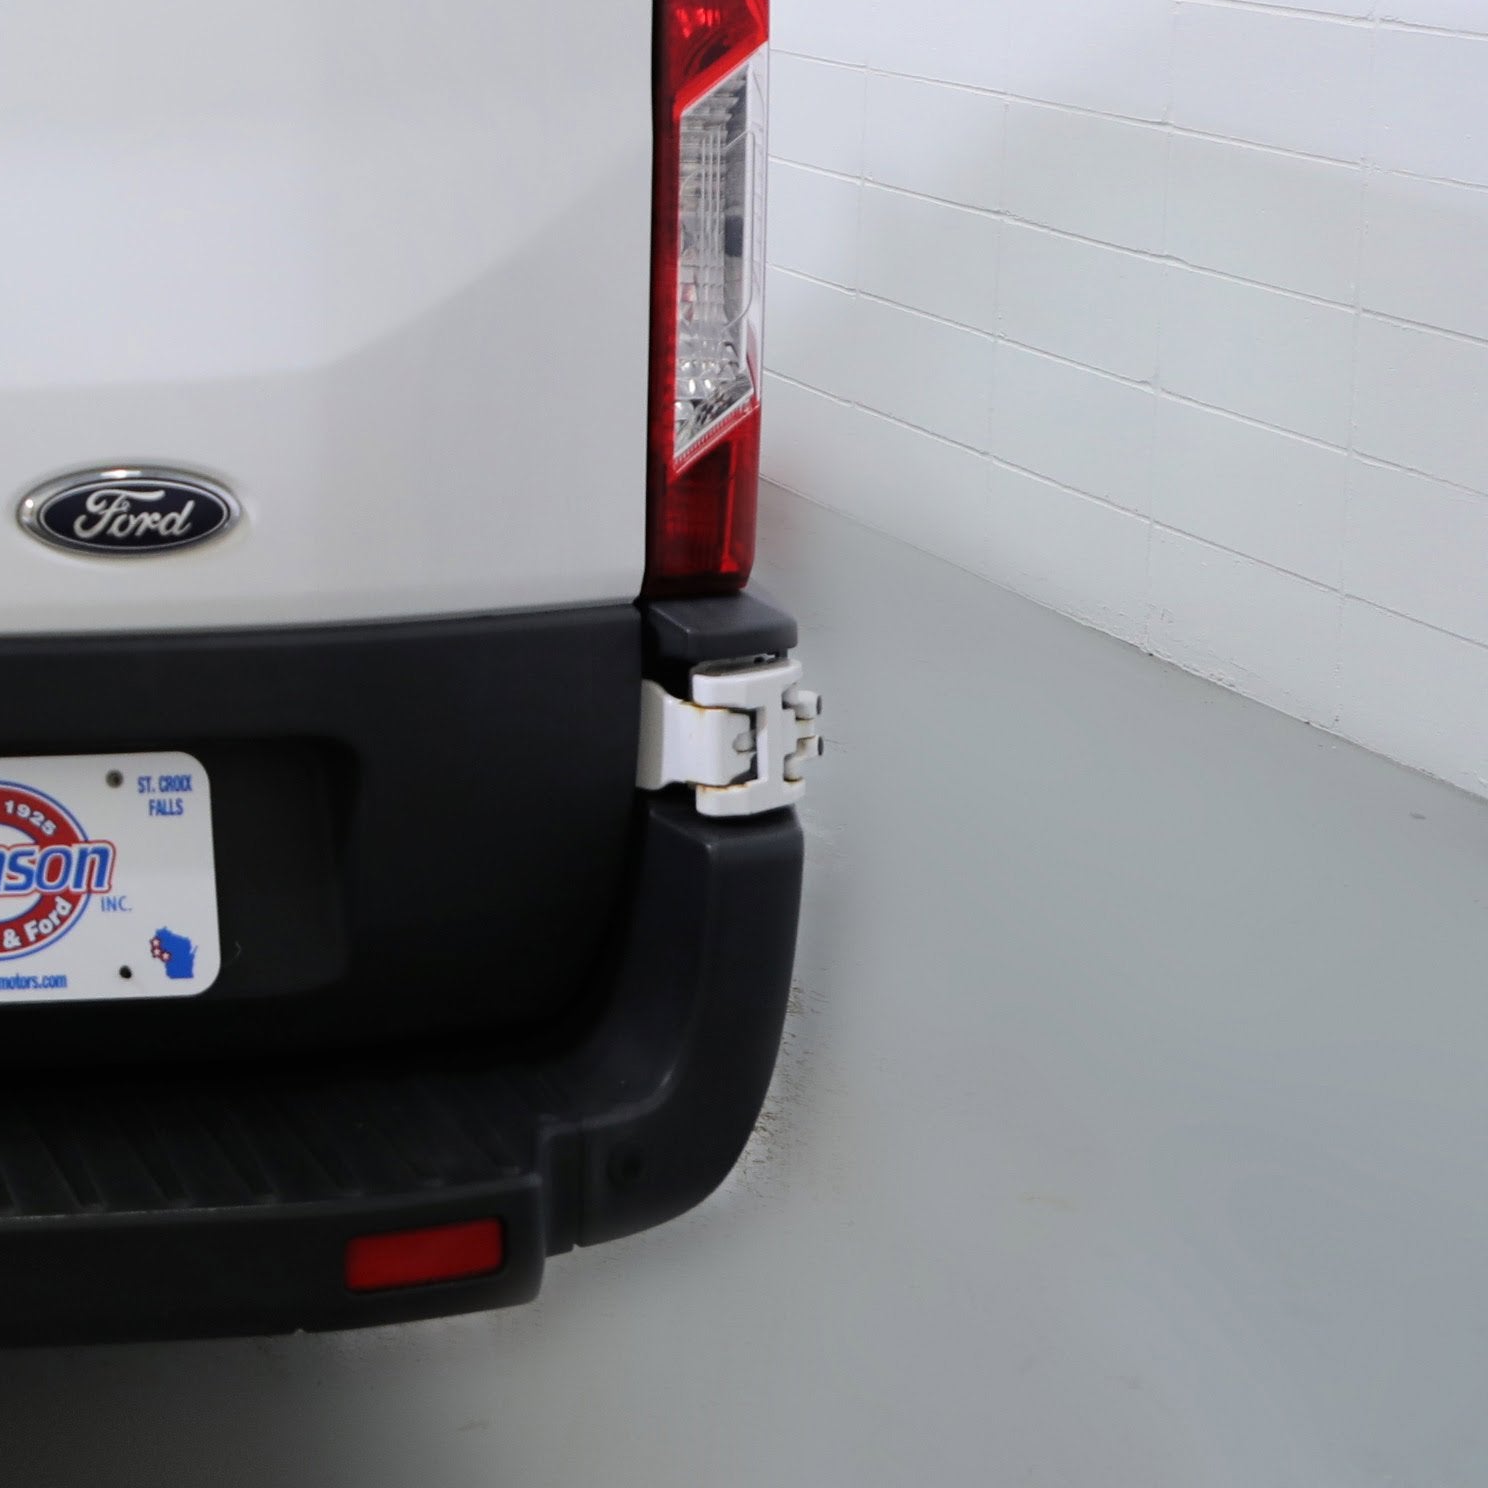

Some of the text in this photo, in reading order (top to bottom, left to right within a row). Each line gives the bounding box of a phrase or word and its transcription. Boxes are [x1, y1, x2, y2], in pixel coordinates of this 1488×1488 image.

[73, 488, 195, 539] Ford
[137, 775, 193, 794] ST. CROIX
[5, 799, 58, 838] 1925
[148, 798, 184, 817] FALLS
[101, 895, 133, 913] INC.
[2, 929, 22, 950] &
[24, 896, 74, 943] Ford
